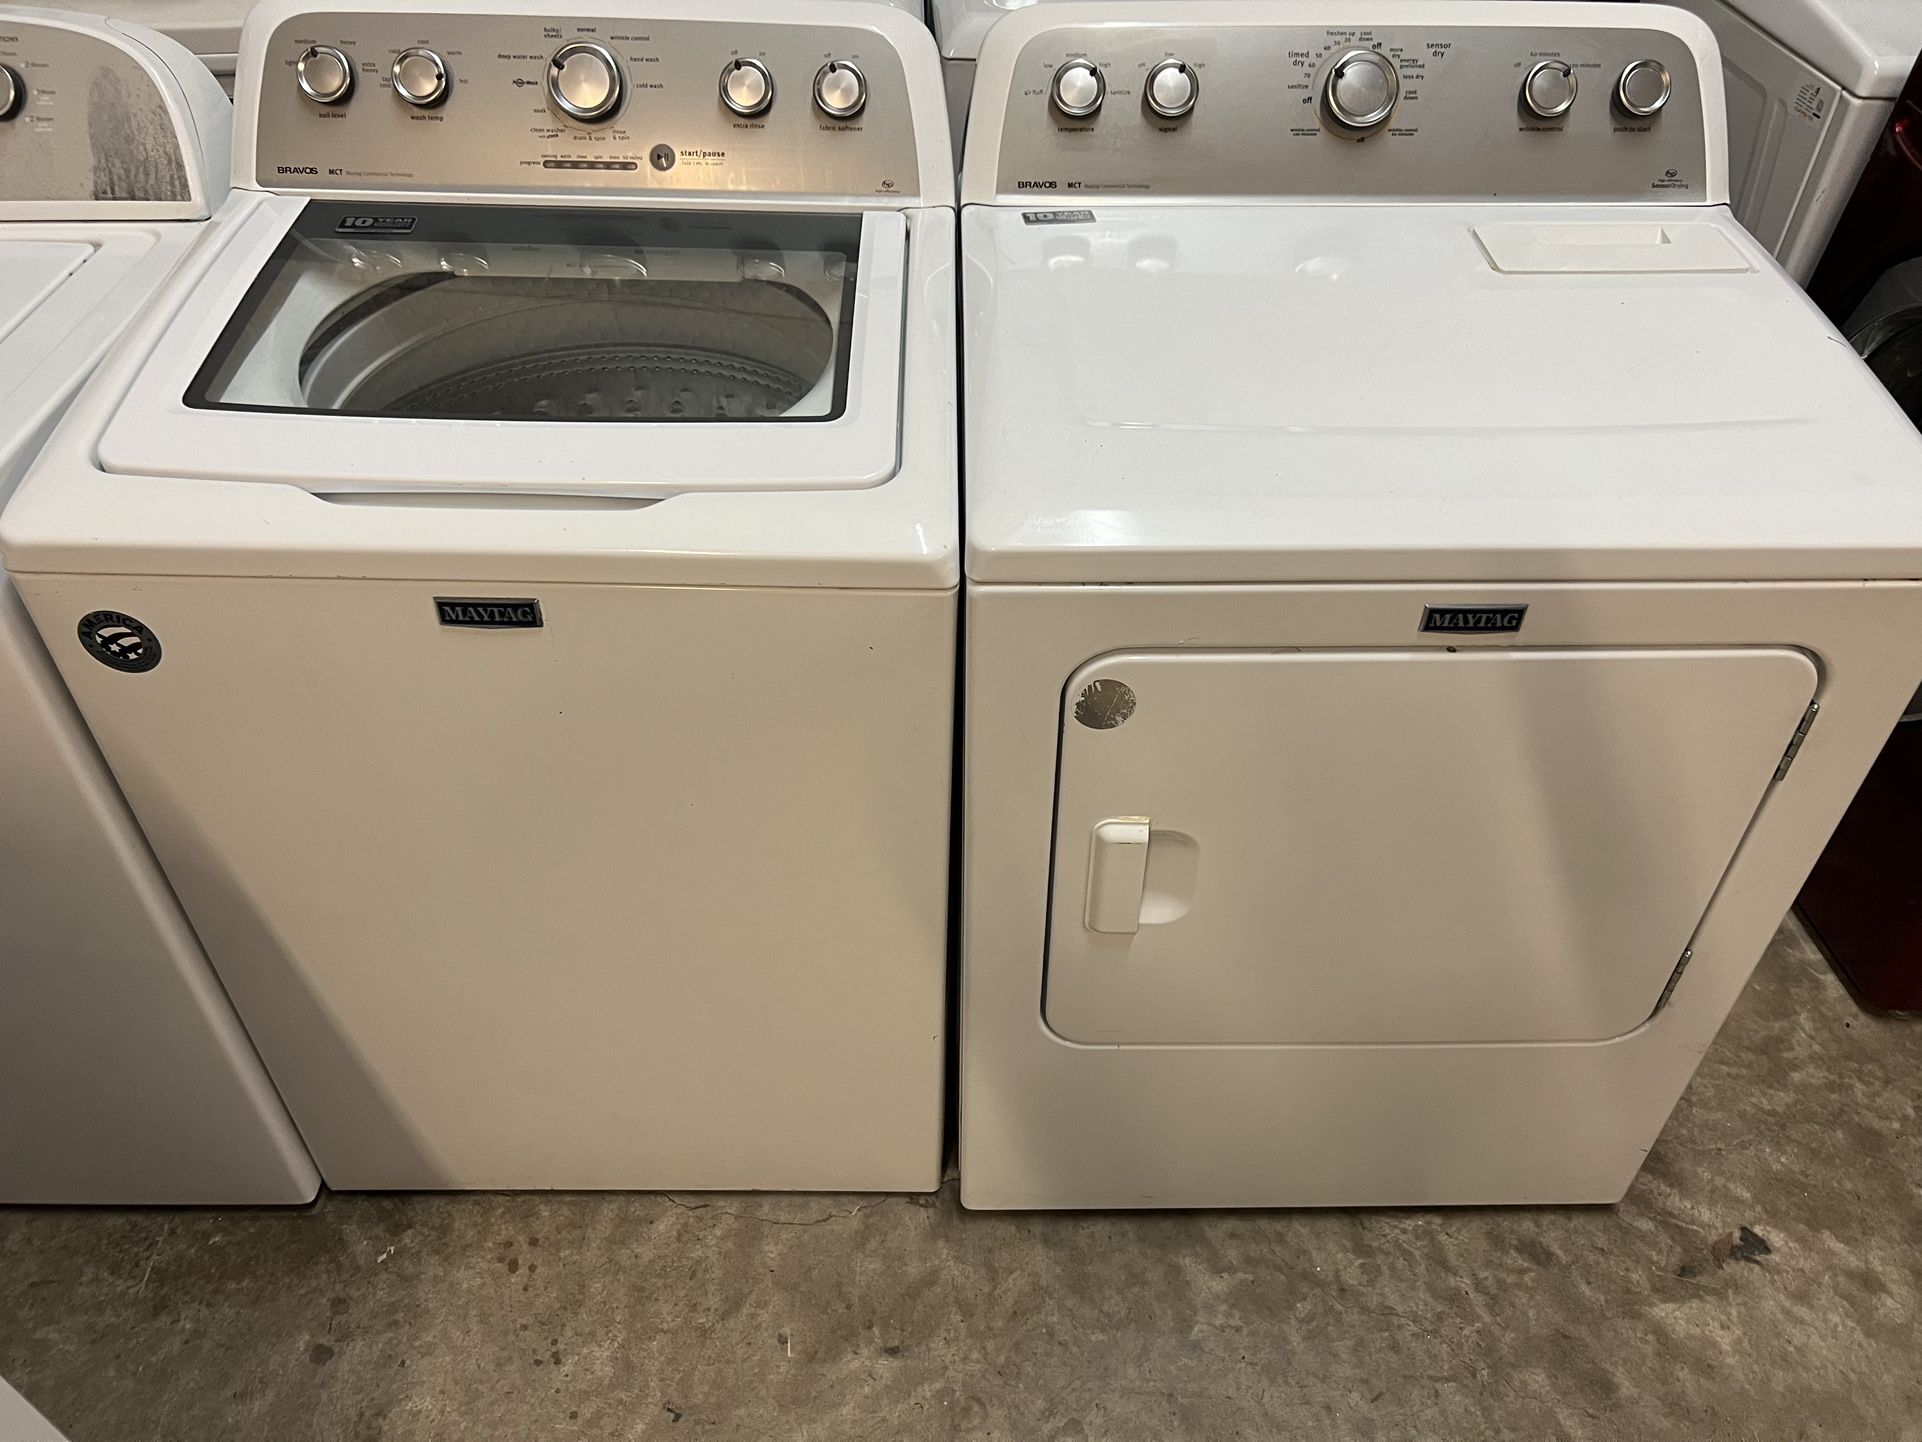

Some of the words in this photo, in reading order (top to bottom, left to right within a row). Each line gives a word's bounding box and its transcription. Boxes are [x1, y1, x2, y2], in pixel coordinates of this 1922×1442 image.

[1372, 42, 1382, 50] off
[1432, 50, 1445, 58] dry
[1293, 59, 1305, 67] dry
[427, 115, 444, 123] temp
[680, 149, 725, 158] start/pause
[277, 167, 318, 175] BRAVOS
[1026, 213, 1054, 221] 10
[345, 217, 374, 226] 10
[444, 606, 534, 623] MAYTAG
[1429, 612, 1519, 628] MAYTAG
[81, 612, 145, 639] AMERICA
